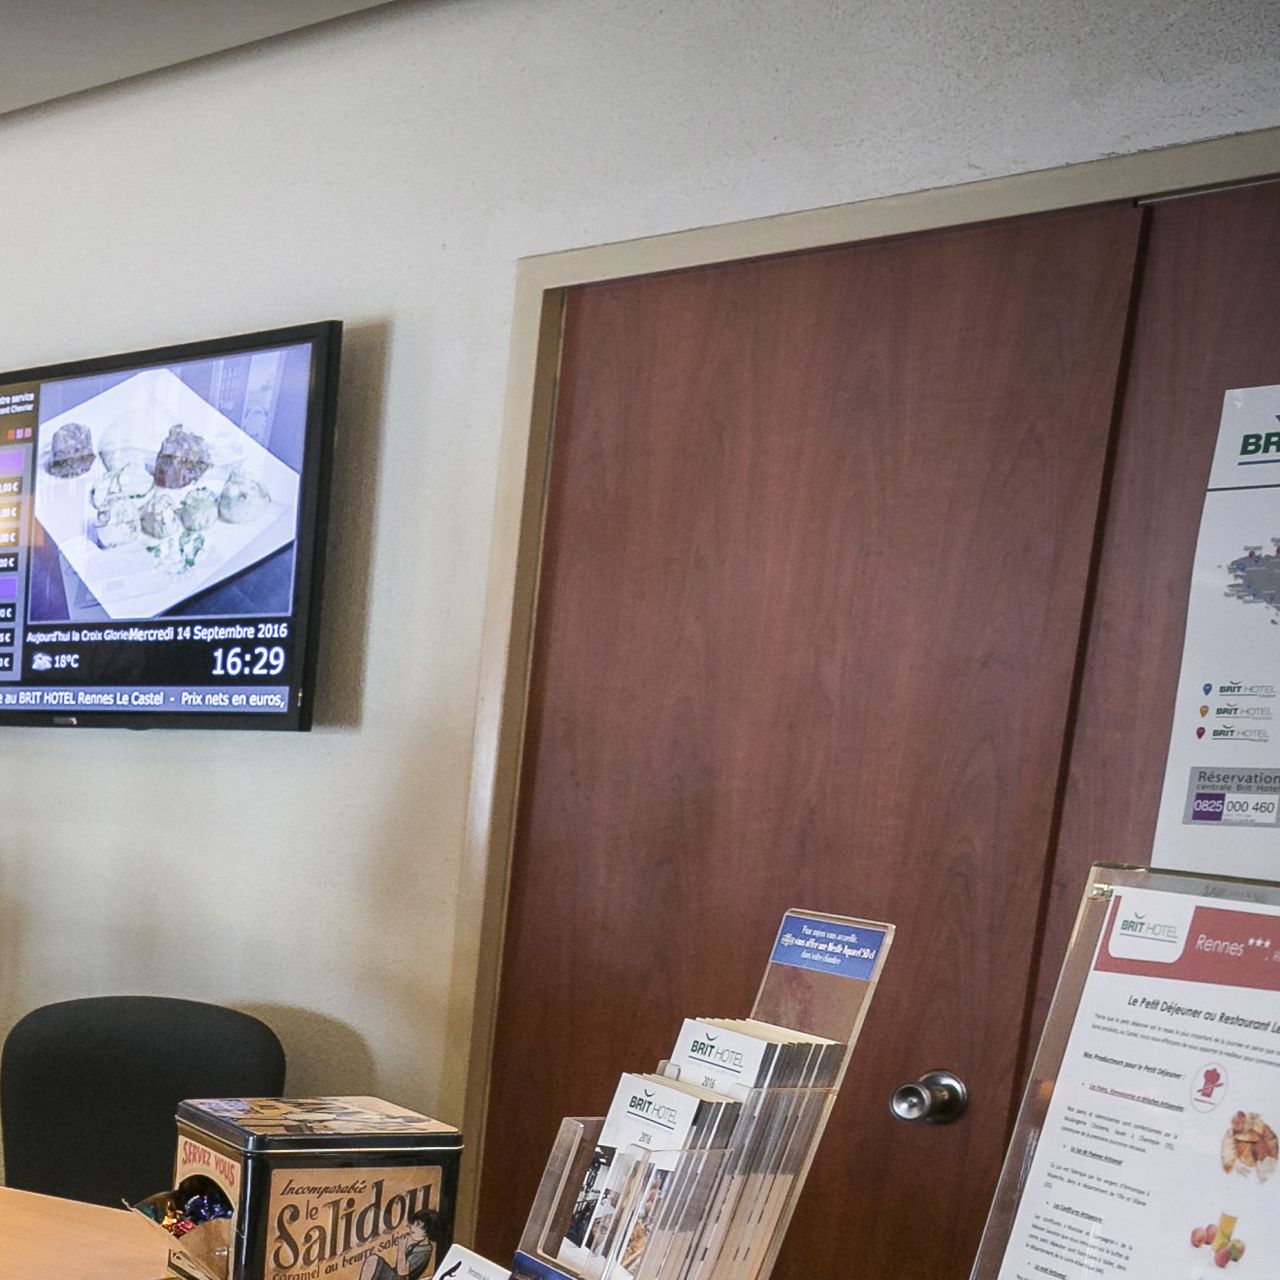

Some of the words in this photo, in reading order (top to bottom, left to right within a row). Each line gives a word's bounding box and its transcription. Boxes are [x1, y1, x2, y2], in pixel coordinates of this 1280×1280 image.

[11, 392, 35, 404] service
[26, 630, 71, 644] Aujourd'hui
[72, 630, 80, 641] la
[81, 630, 103, 641] Croix
[129, 625, 175, 641] Mercredi
[177, 626, 191, 640] 14
[193, 624, 255, 642] Septembre
[257, 623, 288, 639] 2016
[212, 646, 285, 675] 16:29
[4, 694, 18, 705] au
[19, 690, 42, 704] BRIT
[43, 690, 76, 705] HOTEL
[78, 691, 114, 705] Rennes
[116, 691, 130, 705] Le
[130, 691, 164, 706] Castel
[181, 691, 203, 705] Prix
[205, 692, 230, 706] nets
[231, 694, 247, 706] en
[1219, 685, 1242, 693] BRIT
[1244, 685, 1276, 694] HOTEL
[1216, 707, 1239, 715] BRIT
[1241, 707, 1272, 716] HOTEL
[1212, 729, 1235, 737] BRIT
[1237, 729, 1269, 738] HOTEL
[1236, 783, 1252, 792] Brit
[1194, 799, 1223, 812] 0825
[1226, 800, 1249, 813] 000
[1252, 801, 1275, 814] 460
[1120, 919, 1145, 933] BRIT
[1145, 921, 1179, 939] HOTEL
[1195, 934, 1246, 957] Rennes
[1128, 995, 1139, 1007] Le
[1139, 997, 1159, 1011] Petit
[1159, 1000, 1203, 1019] Déjeuner
[1203, 1009, 1218, 1022] au
[1218, 1011, 1272, 1033] Restaurant
[690, 1040, 715, 1057] BRIT
[715, 1046, 744, 1068] HOTEL
[701, 1075, 717, 1089] 2016
[629, 1095, 653, 1113] BRIT
[652, 1101, 677, 1125] HOTEL
[638, 1131, 653, 1145] 2016
[182, 1140, 211, 1165] SERVEZ
[214, 1154, 236, 1186] VOUS
[306, 1200, 319, 1221] le
[273, 1179, 433, 1271] Salidou
[325, 1261, 338, 1275] au
[342, 1247, 375, 1269] beurre
